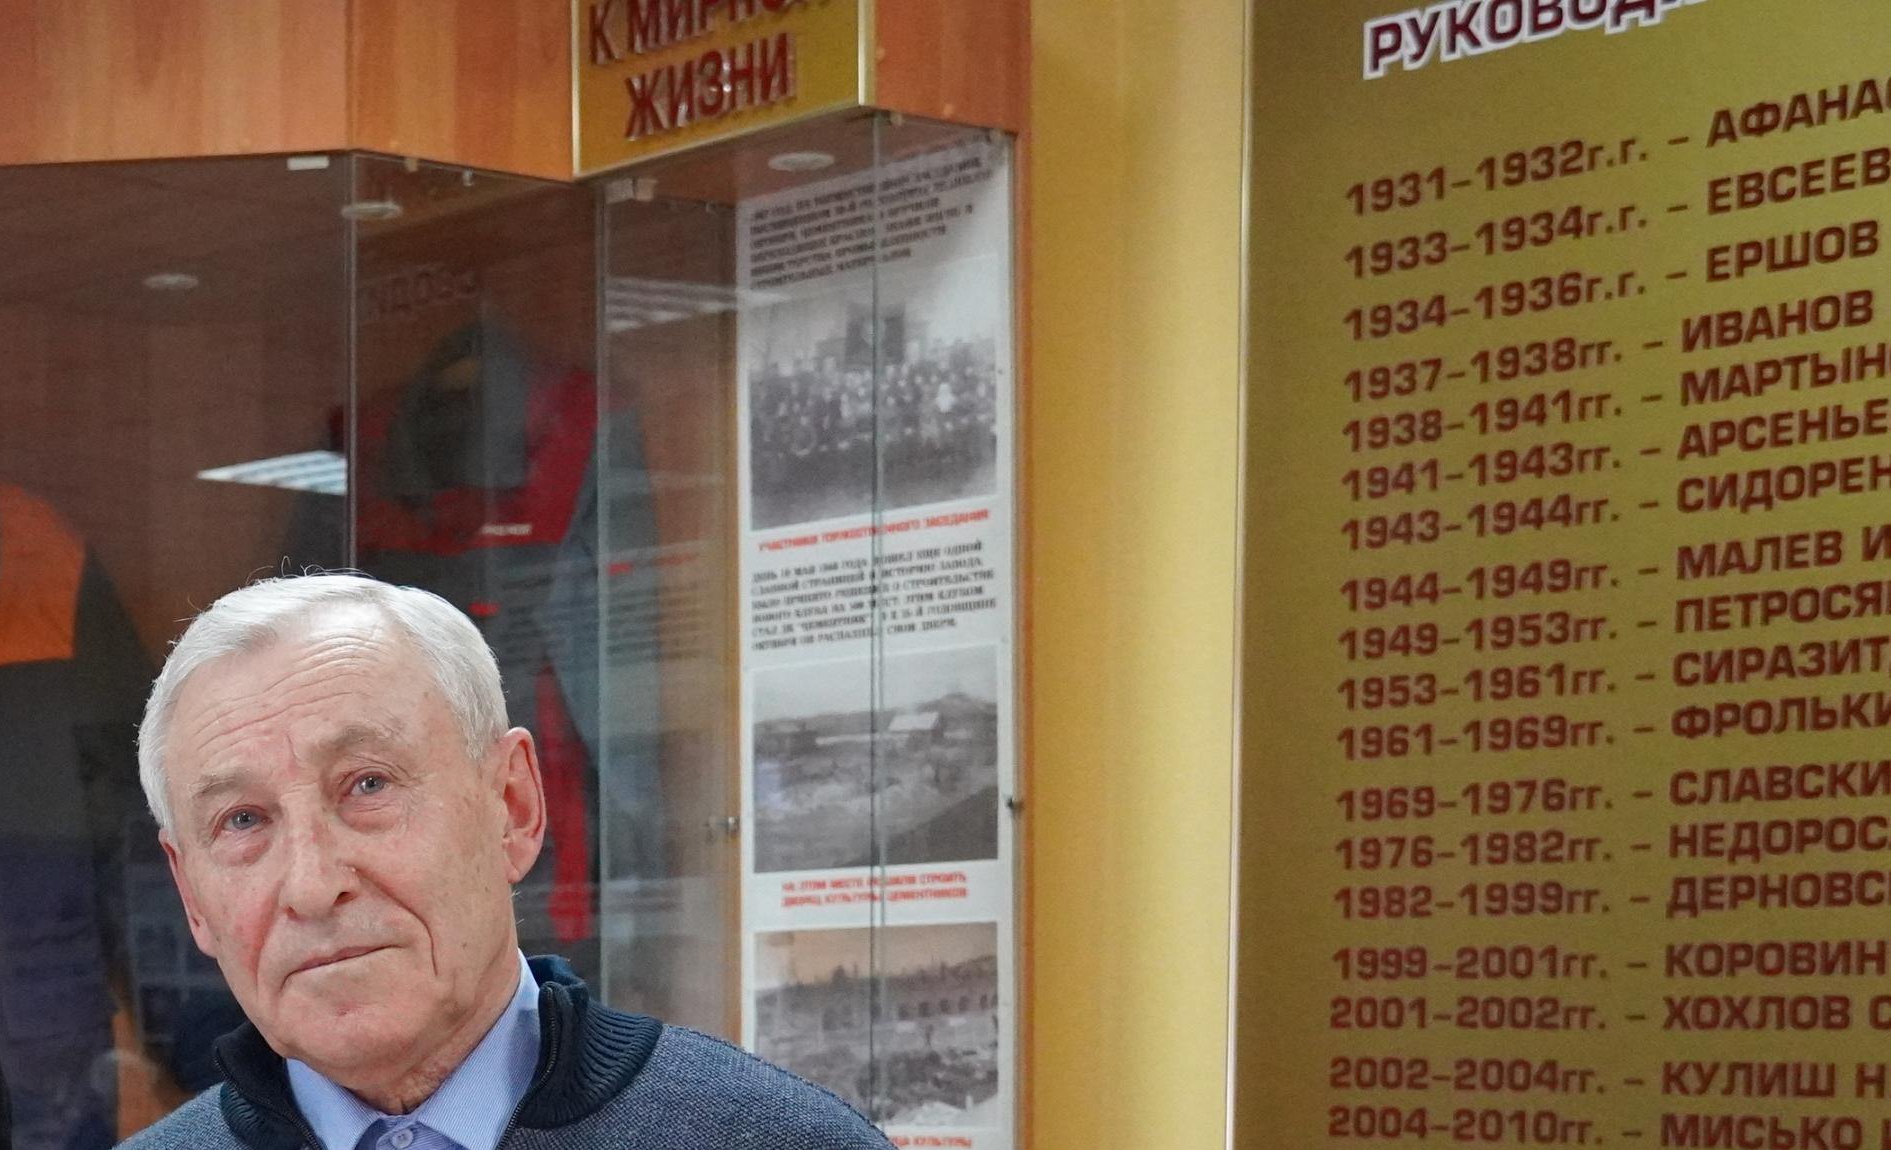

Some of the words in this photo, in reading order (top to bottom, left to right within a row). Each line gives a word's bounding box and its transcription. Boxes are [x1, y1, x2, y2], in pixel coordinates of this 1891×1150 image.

[625, 33, 792, 140] ЖИЗНИ
[1706, 76, 1891, 147] АФАНА
[1707, 147, 1891, 215] ЕВСЕЕВ
[1706, 220, 1879, 282] ЕРШОВ
[1681, 290, 1873, 352] ИВАНОВ
[1680, 343, 1891, 407] МАРТЫН
[1677, 530, 1843, 580] МАЛЕВ
[1675, 581, 1891, 633] ПЕТРОСЯ
[1673, 636, 1891, 687] СИРАЗИТ
[1669, 816, 1891, 864] НЕДОРОС
[1666, 871, 1891, 919] ДЕРНОВС
[1665, 941, 1887, 978] КОРОВИН
[1663, 995, 1851, 1031] ХОХЛОВ
[1662, 1061, 1836, 1097] КУЛИШ
[1660, 1114, 1863, 1150] МИСЬКО
